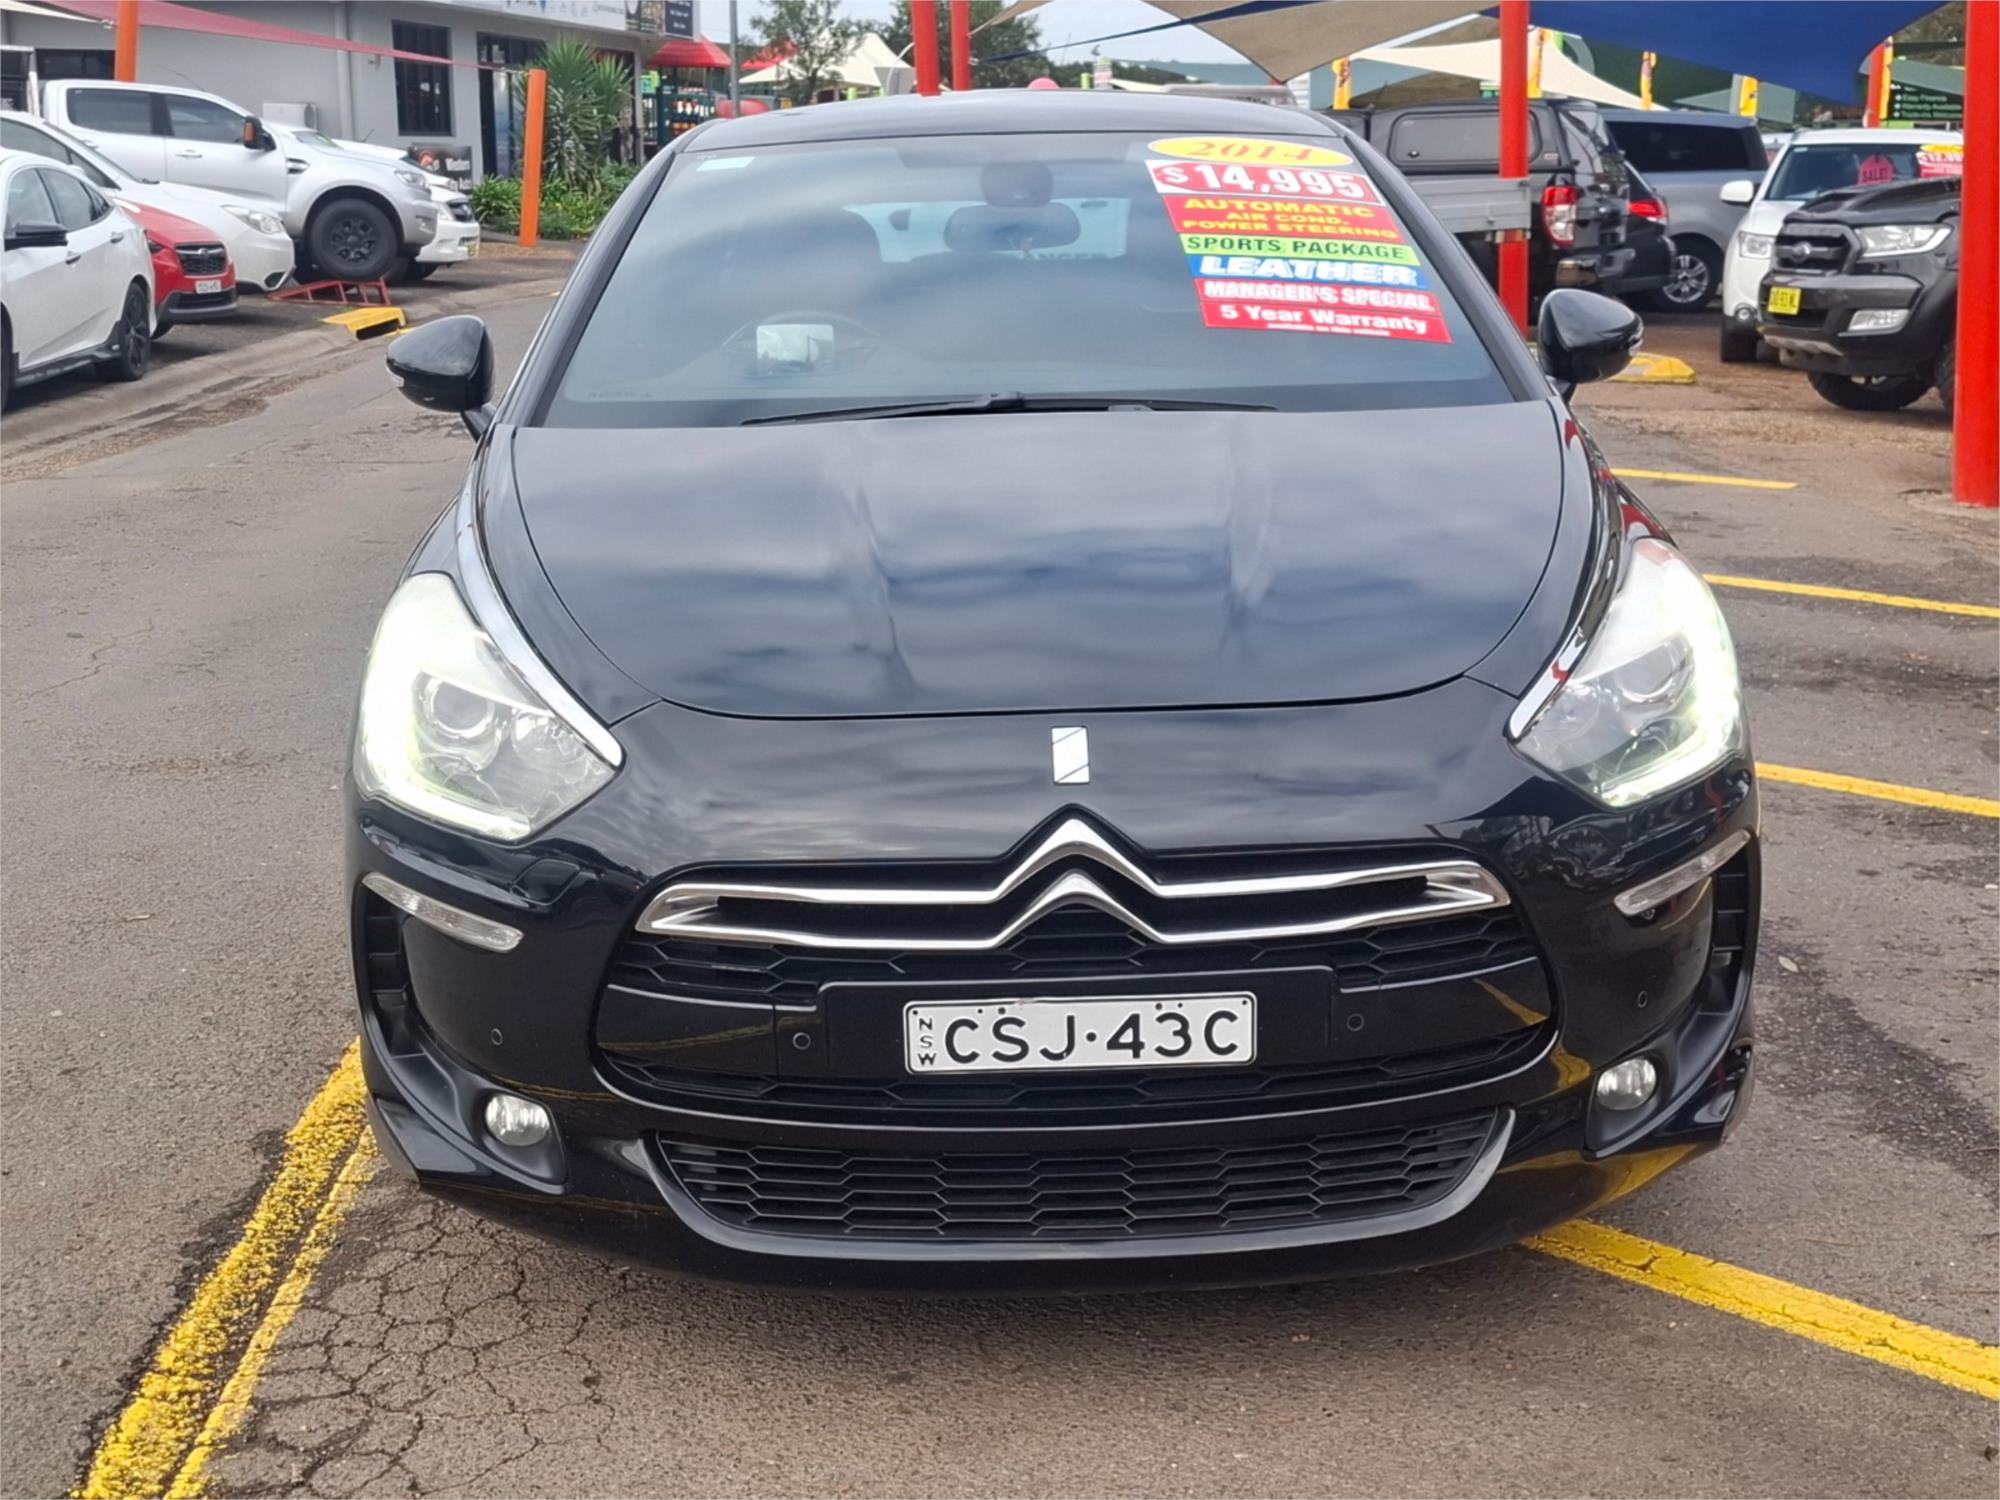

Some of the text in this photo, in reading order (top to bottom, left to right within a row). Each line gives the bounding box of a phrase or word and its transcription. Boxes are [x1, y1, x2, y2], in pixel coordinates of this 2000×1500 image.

[1186, 141, 1314, 161] 2014
[1161, 163, 1366, 199] $14,995
[1183, 198, 1376, 218] AUTOMATIC
[1226, 211, 1349, 226] AIR COND.
[1182, 220, 1399, 239] POWER STEERING
[1187, 235, 1405, 259] SPORTS PACKAGE
[1200, 256, 1418, 287] LEATHER
[1204, 280, 1436, 312] MANAGER'S SPECIAL
[1220, 304, 1427, 334] 5 Year Warranty
